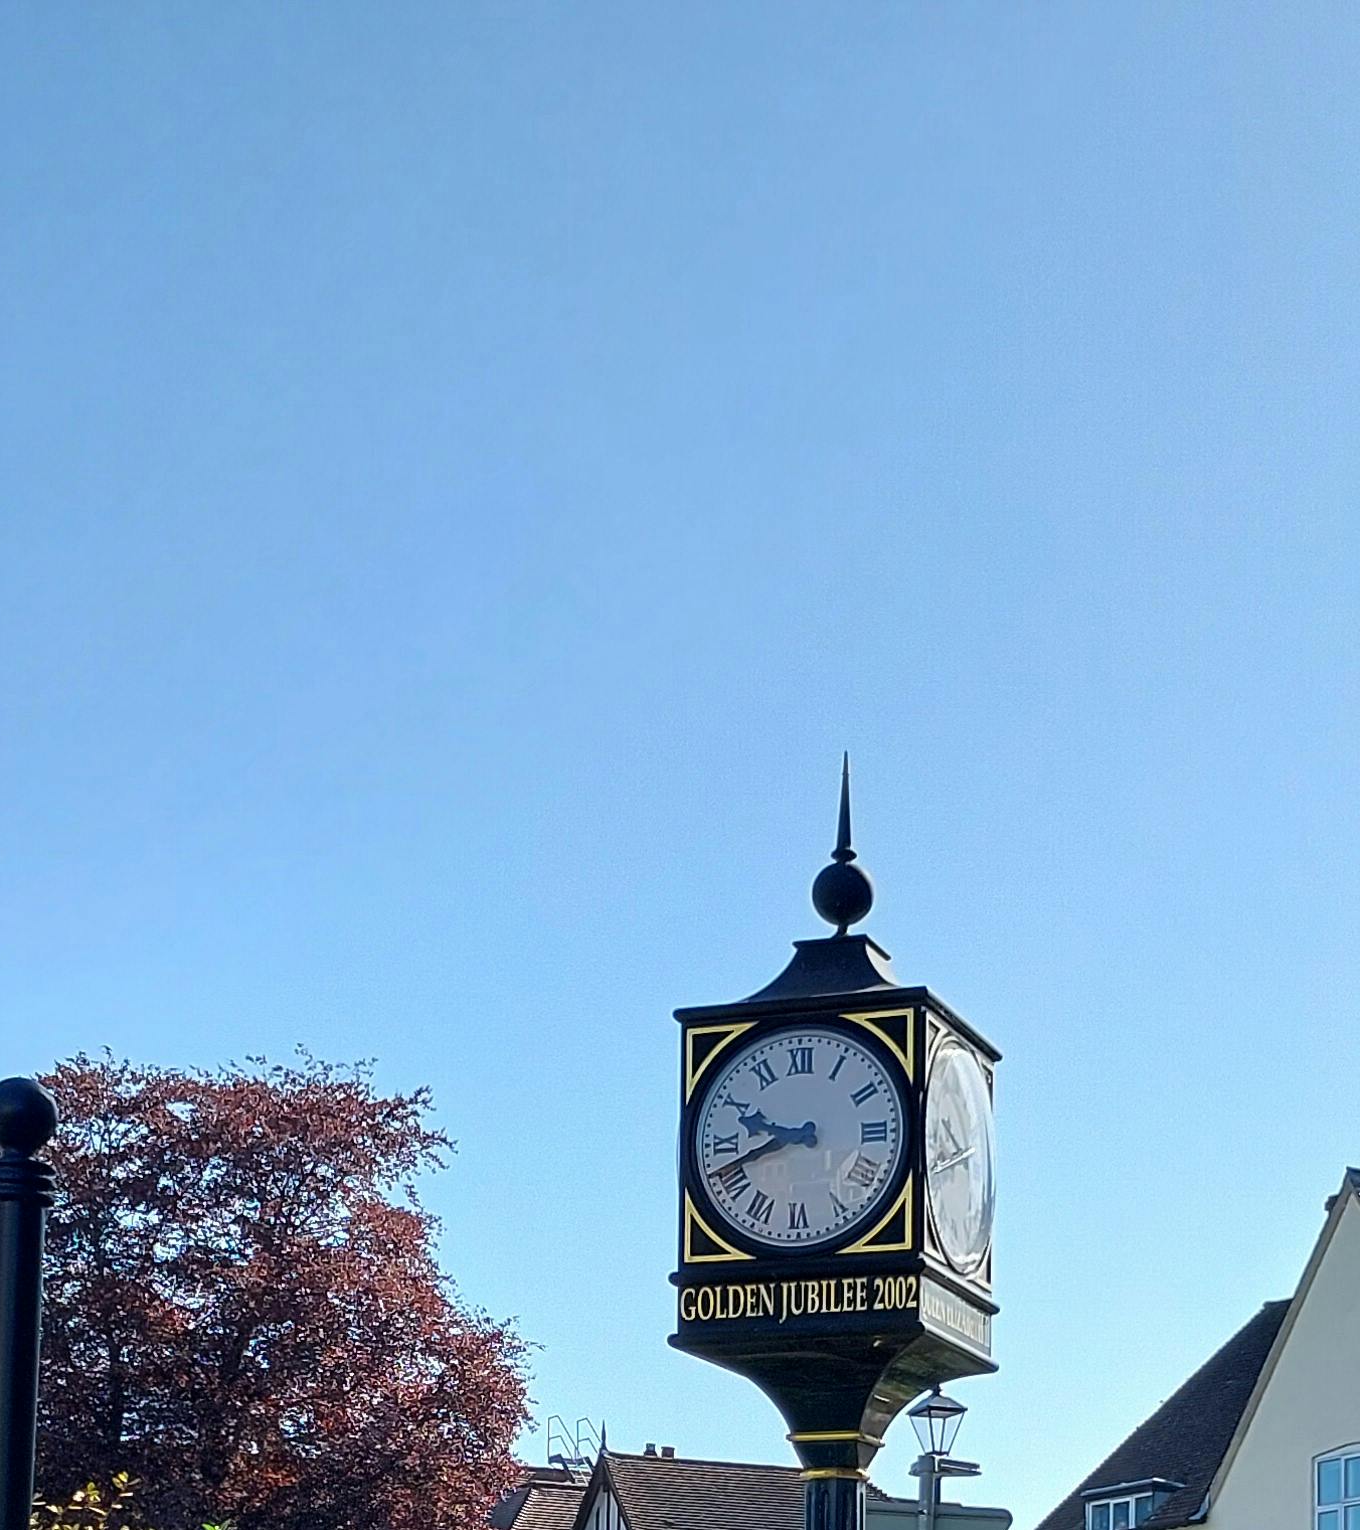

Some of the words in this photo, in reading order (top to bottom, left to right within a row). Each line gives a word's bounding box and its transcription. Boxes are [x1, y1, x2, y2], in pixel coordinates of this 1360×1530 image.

[786, 1046, 814, 1076] XII
[680, 1284, 776, 1322] GOLDEN
[779, 1276, 868, 1324] JUBILEE
[873, 1276, 918, 1310] 2002
